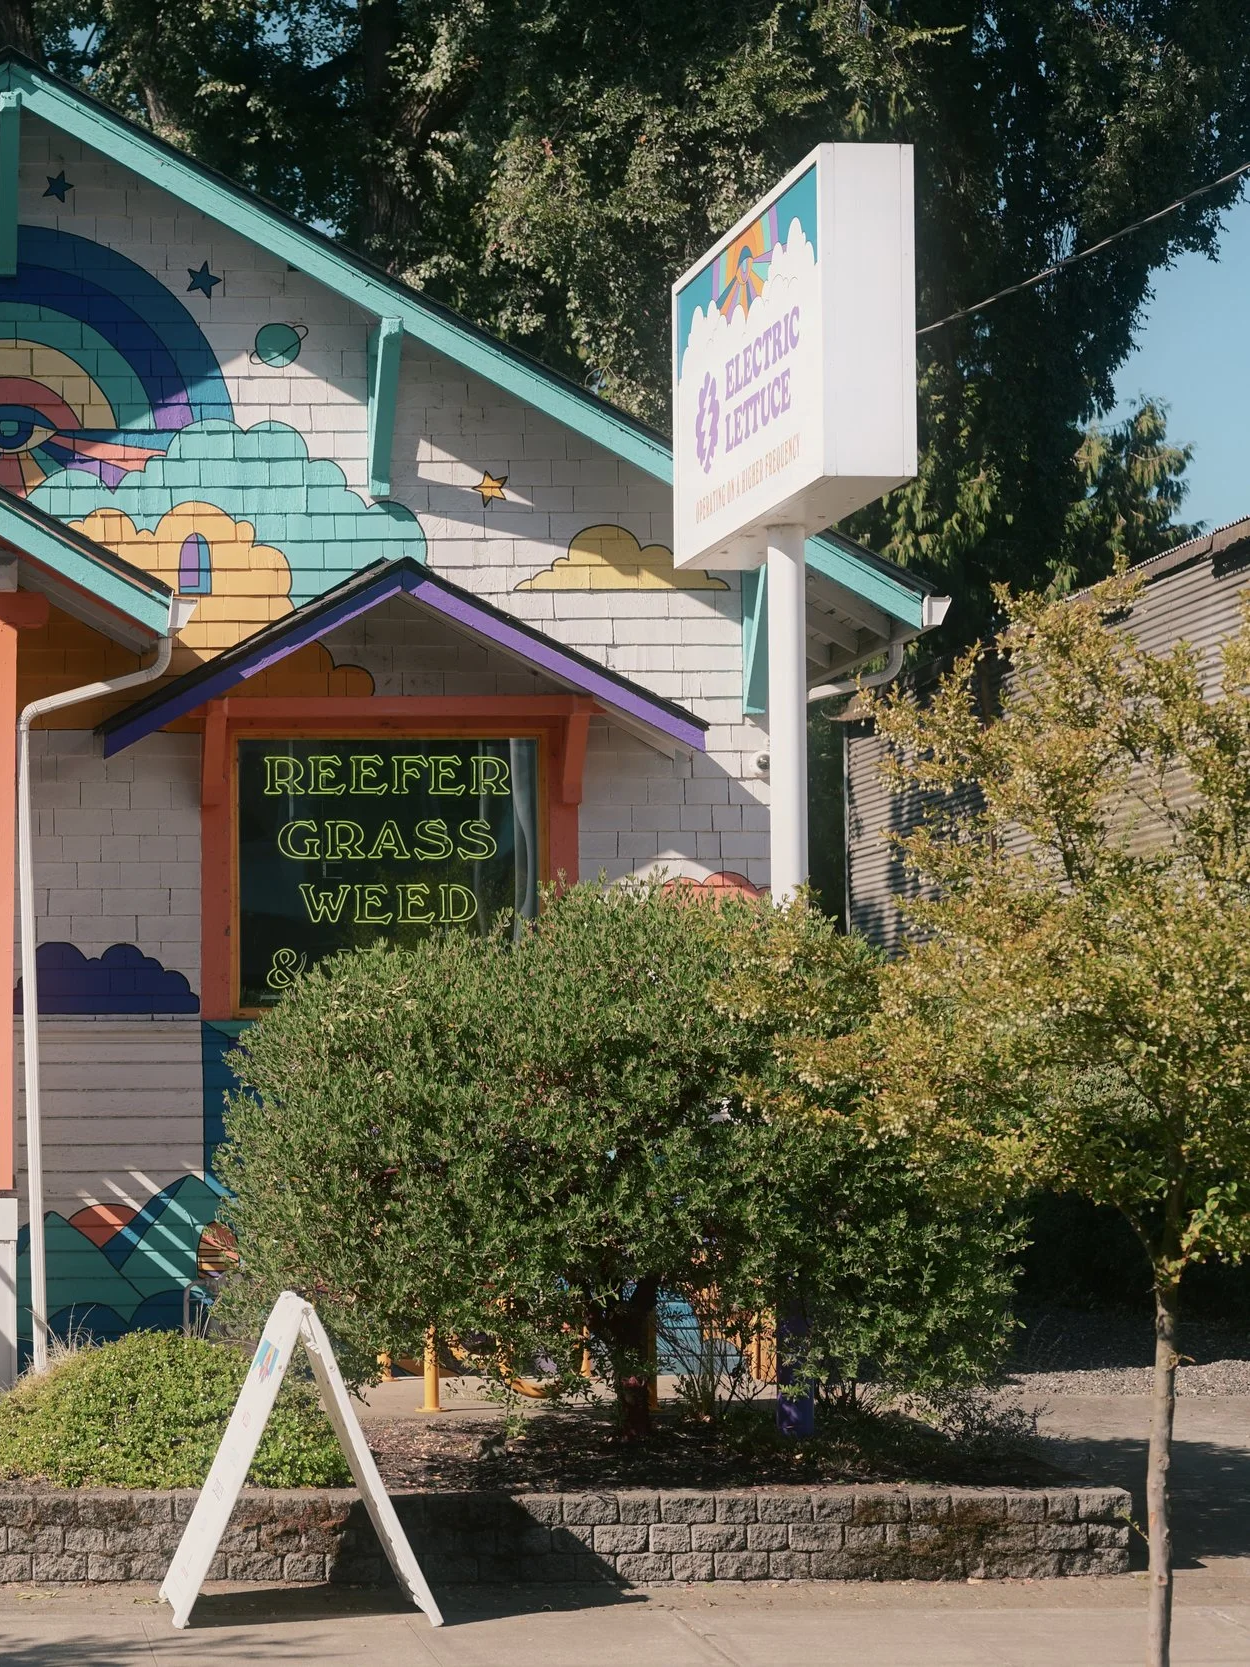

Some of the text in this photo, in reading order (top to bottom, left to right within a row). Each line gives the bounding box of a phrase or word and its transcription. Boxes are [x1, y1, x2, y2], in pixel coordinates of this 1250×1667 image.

[725, 306, 800, 401] ELECTRIC
[725, 368, 791, 454] LETTUCE
[695, 483, 726, 524] OPERATING
[727, 477, 735, 504] ON
[741, 457, 764, 495] HIGHER
[764, 432, 801, 479] FREQUENCY
[263, 754, 511, 796] REEFER
[277, 819, 498, 861] GRASS
[299, 883, 479, 925] WEED
[266, 948, 307, 989] &
